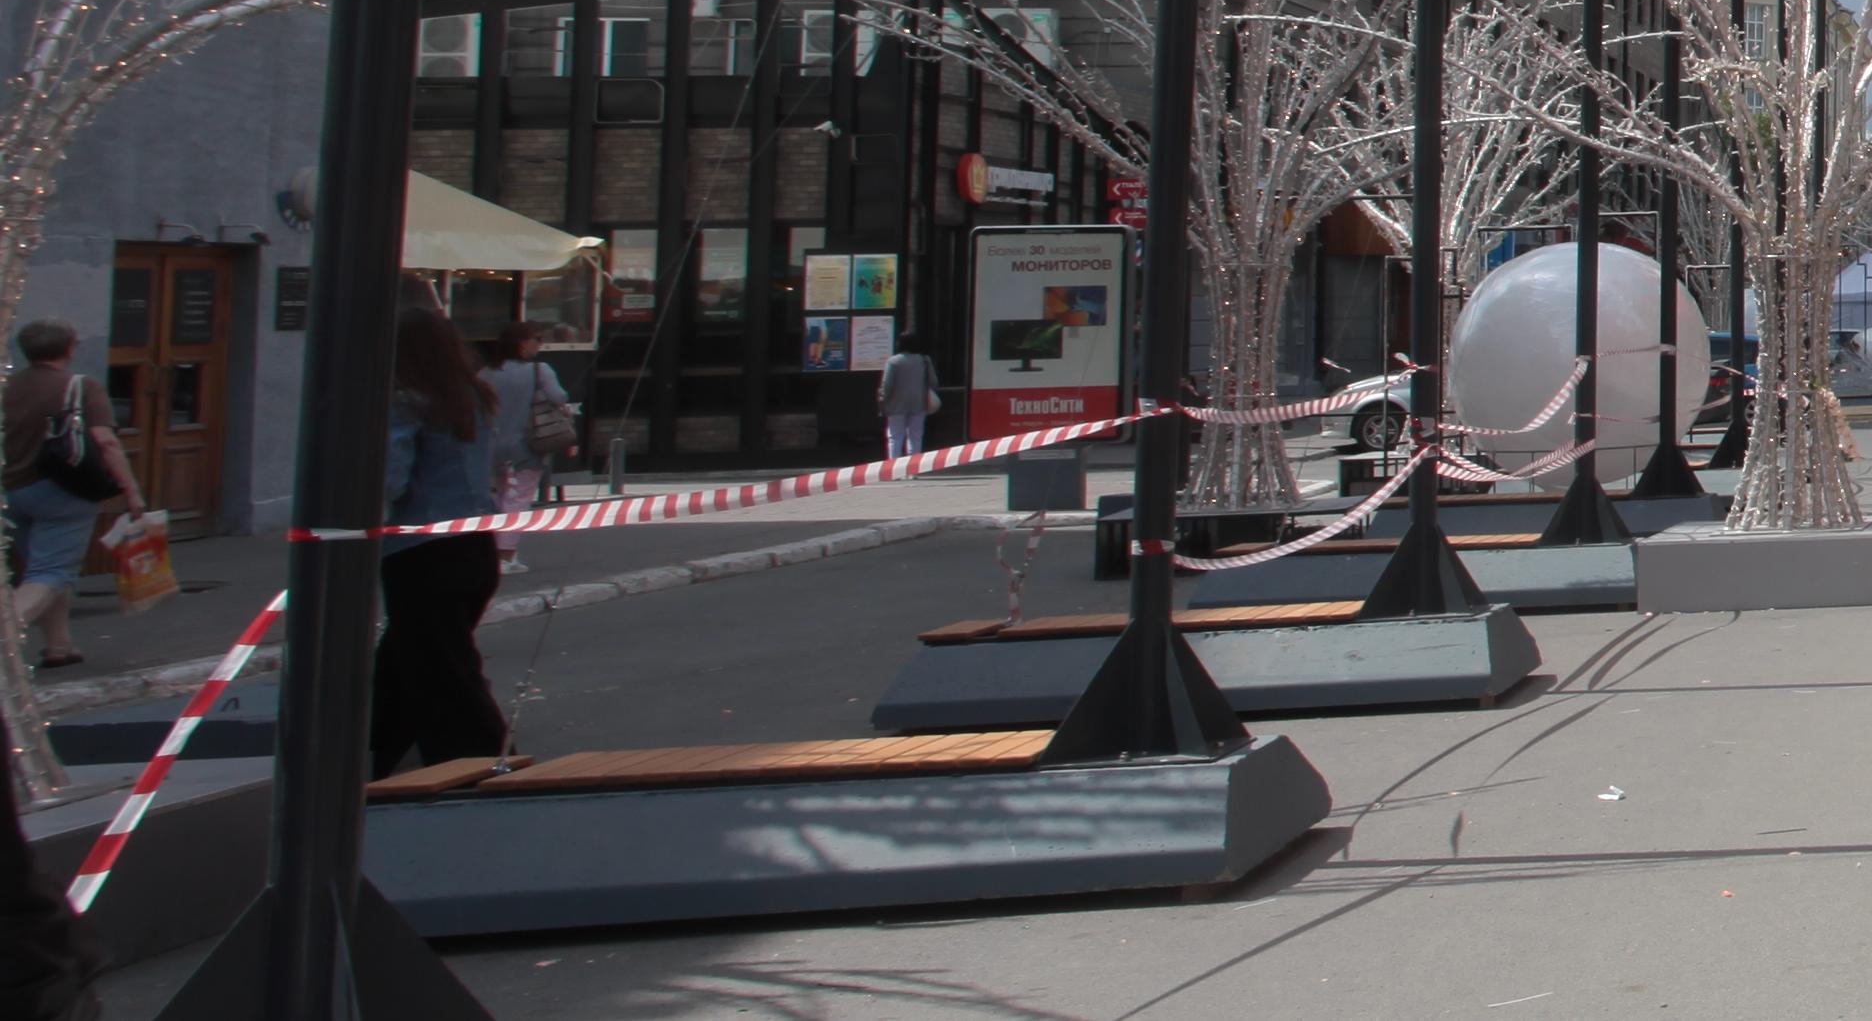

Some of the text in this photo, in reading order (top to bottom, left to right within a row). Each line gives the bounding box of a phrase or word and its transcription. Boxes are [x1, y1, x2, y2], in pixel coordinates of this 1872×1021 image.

[1029, 245, 1045, 255] 30
[1011, 259, 1113, 272] МОНИТОРОВ
[1010, 397, 1084, 414] ТехноСити
